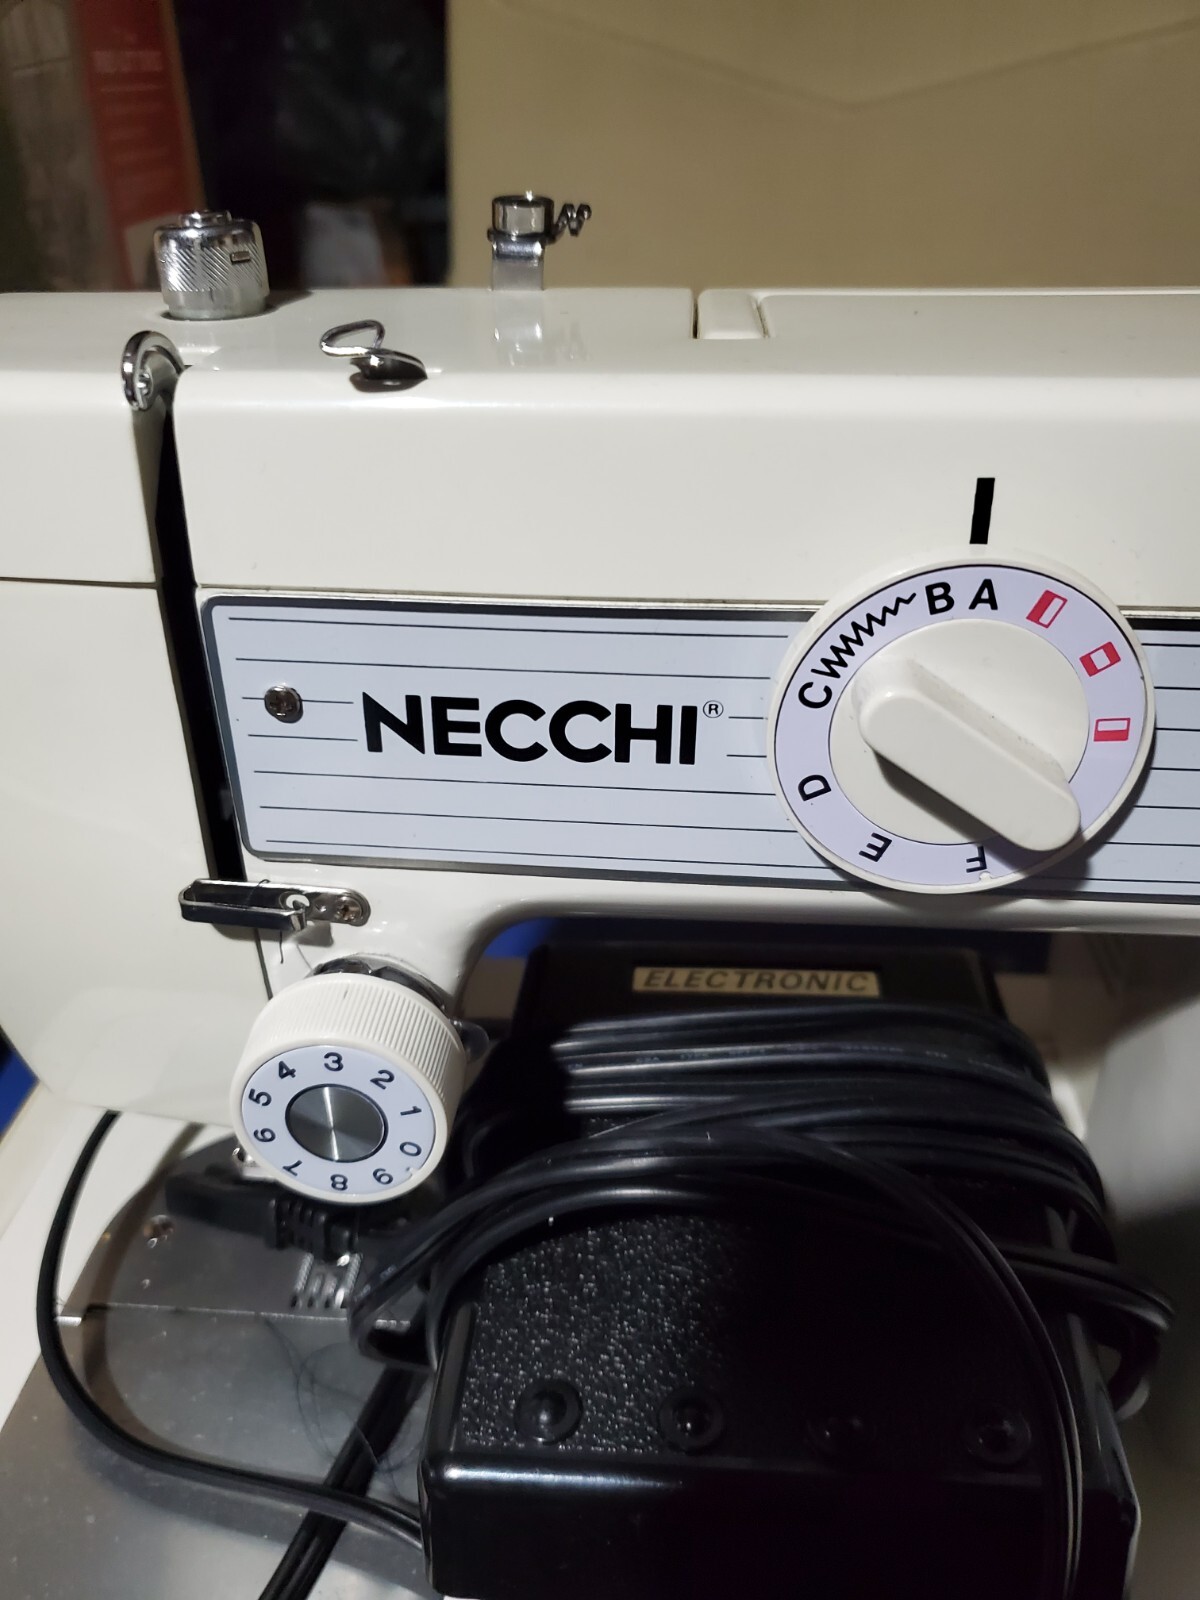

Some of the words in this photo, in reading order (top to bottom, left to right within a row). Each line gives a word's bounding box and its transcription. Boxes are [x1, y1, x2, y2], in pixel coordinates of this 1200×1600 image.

[924, 581, 955, 616] B
[968, 579, 999, 611] A
[798, 682, 832, 709] C
[362, 691, 698, 765] NECCHI
[797, 774, 832, 802] D
[859, 832, 892, 862] E
[965, 845, 988, 873] F
[643, 969, 869, 991] ELECTRONIC
[277, 1060, 296, 1080] 4
[323, 1052, 344, 1072] 3
[370, 1069, 395, 1090] 2
[248, 1088, 272, 1107] 5
[400, 1105, 422, 1116] 1
[253, 1127, 276, 1143] 6
[399, 1141, 422, 1157] 0
[282, 1160, 303, 1177] 7
[372, 1168, 394, 1185] 9
[330, 1173, 348, 1191] 8
